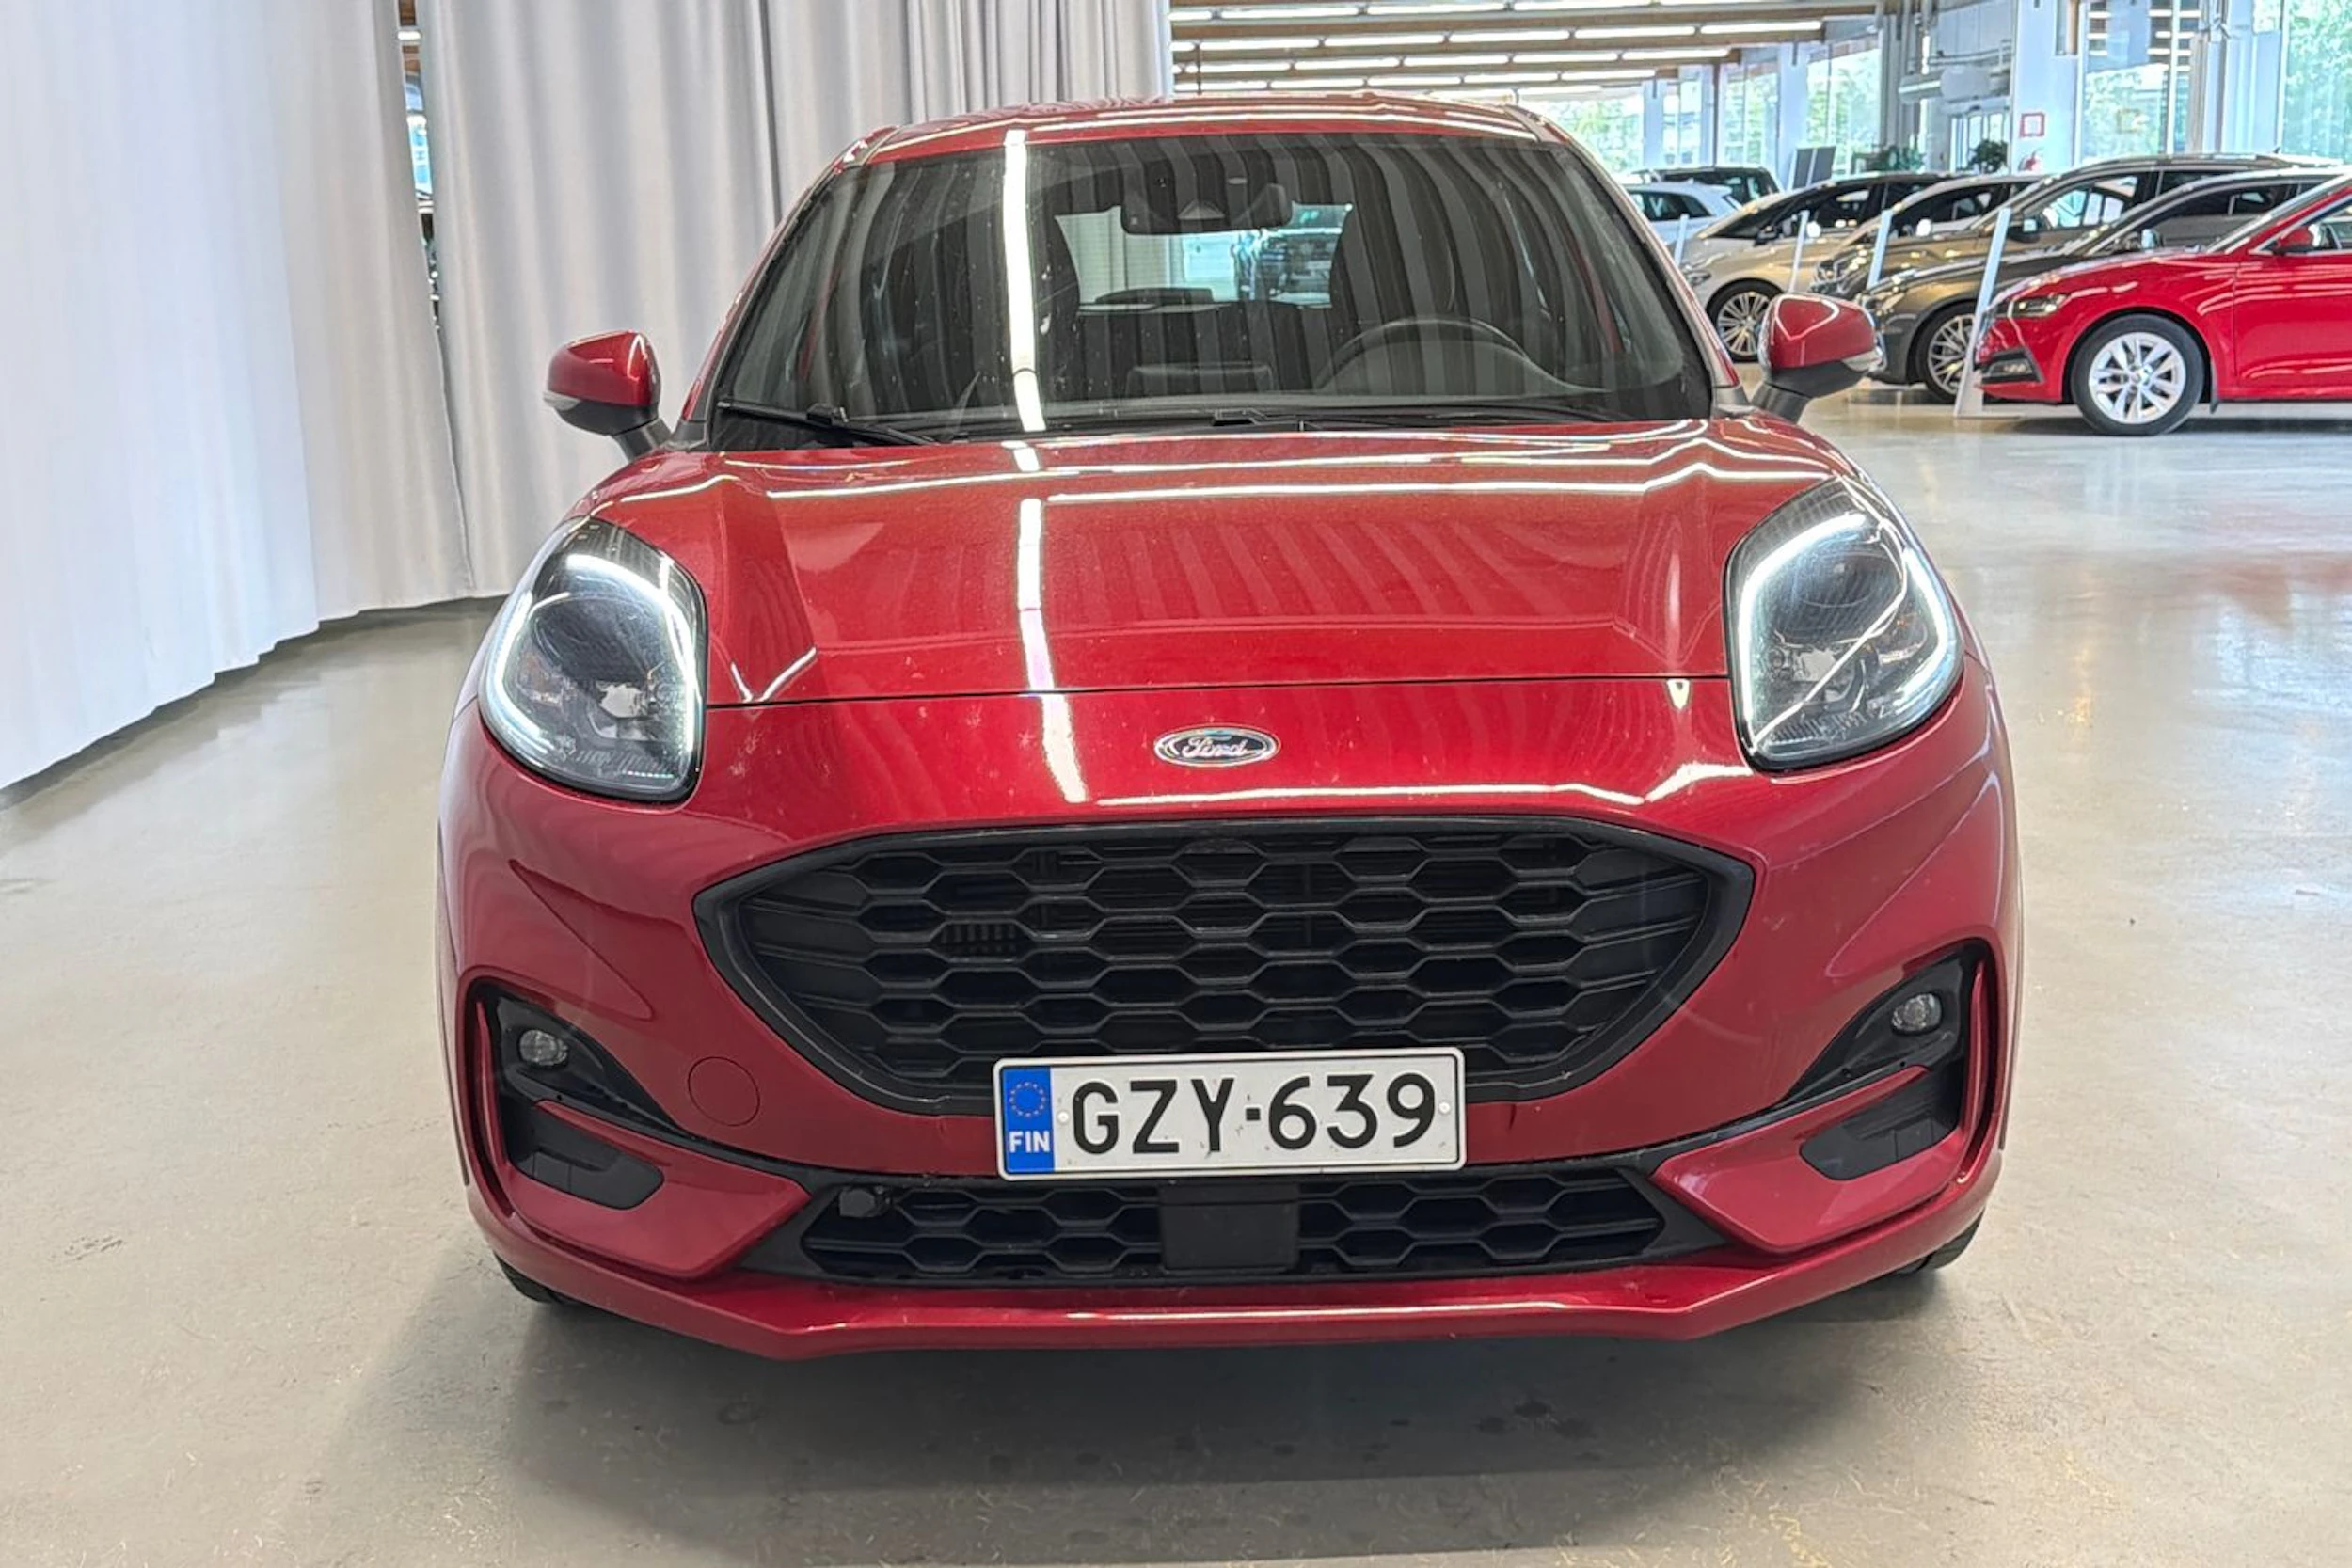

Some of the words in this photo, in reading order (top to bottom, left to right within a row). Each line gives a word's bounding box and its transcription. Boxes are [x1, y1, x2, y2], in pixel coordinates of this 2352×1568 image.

[1182, 736, 1249, 758] Ford
[1073, 1072, 1436, 1154] GZY-639
[1009, 1131, 1050, 1153] FIN
